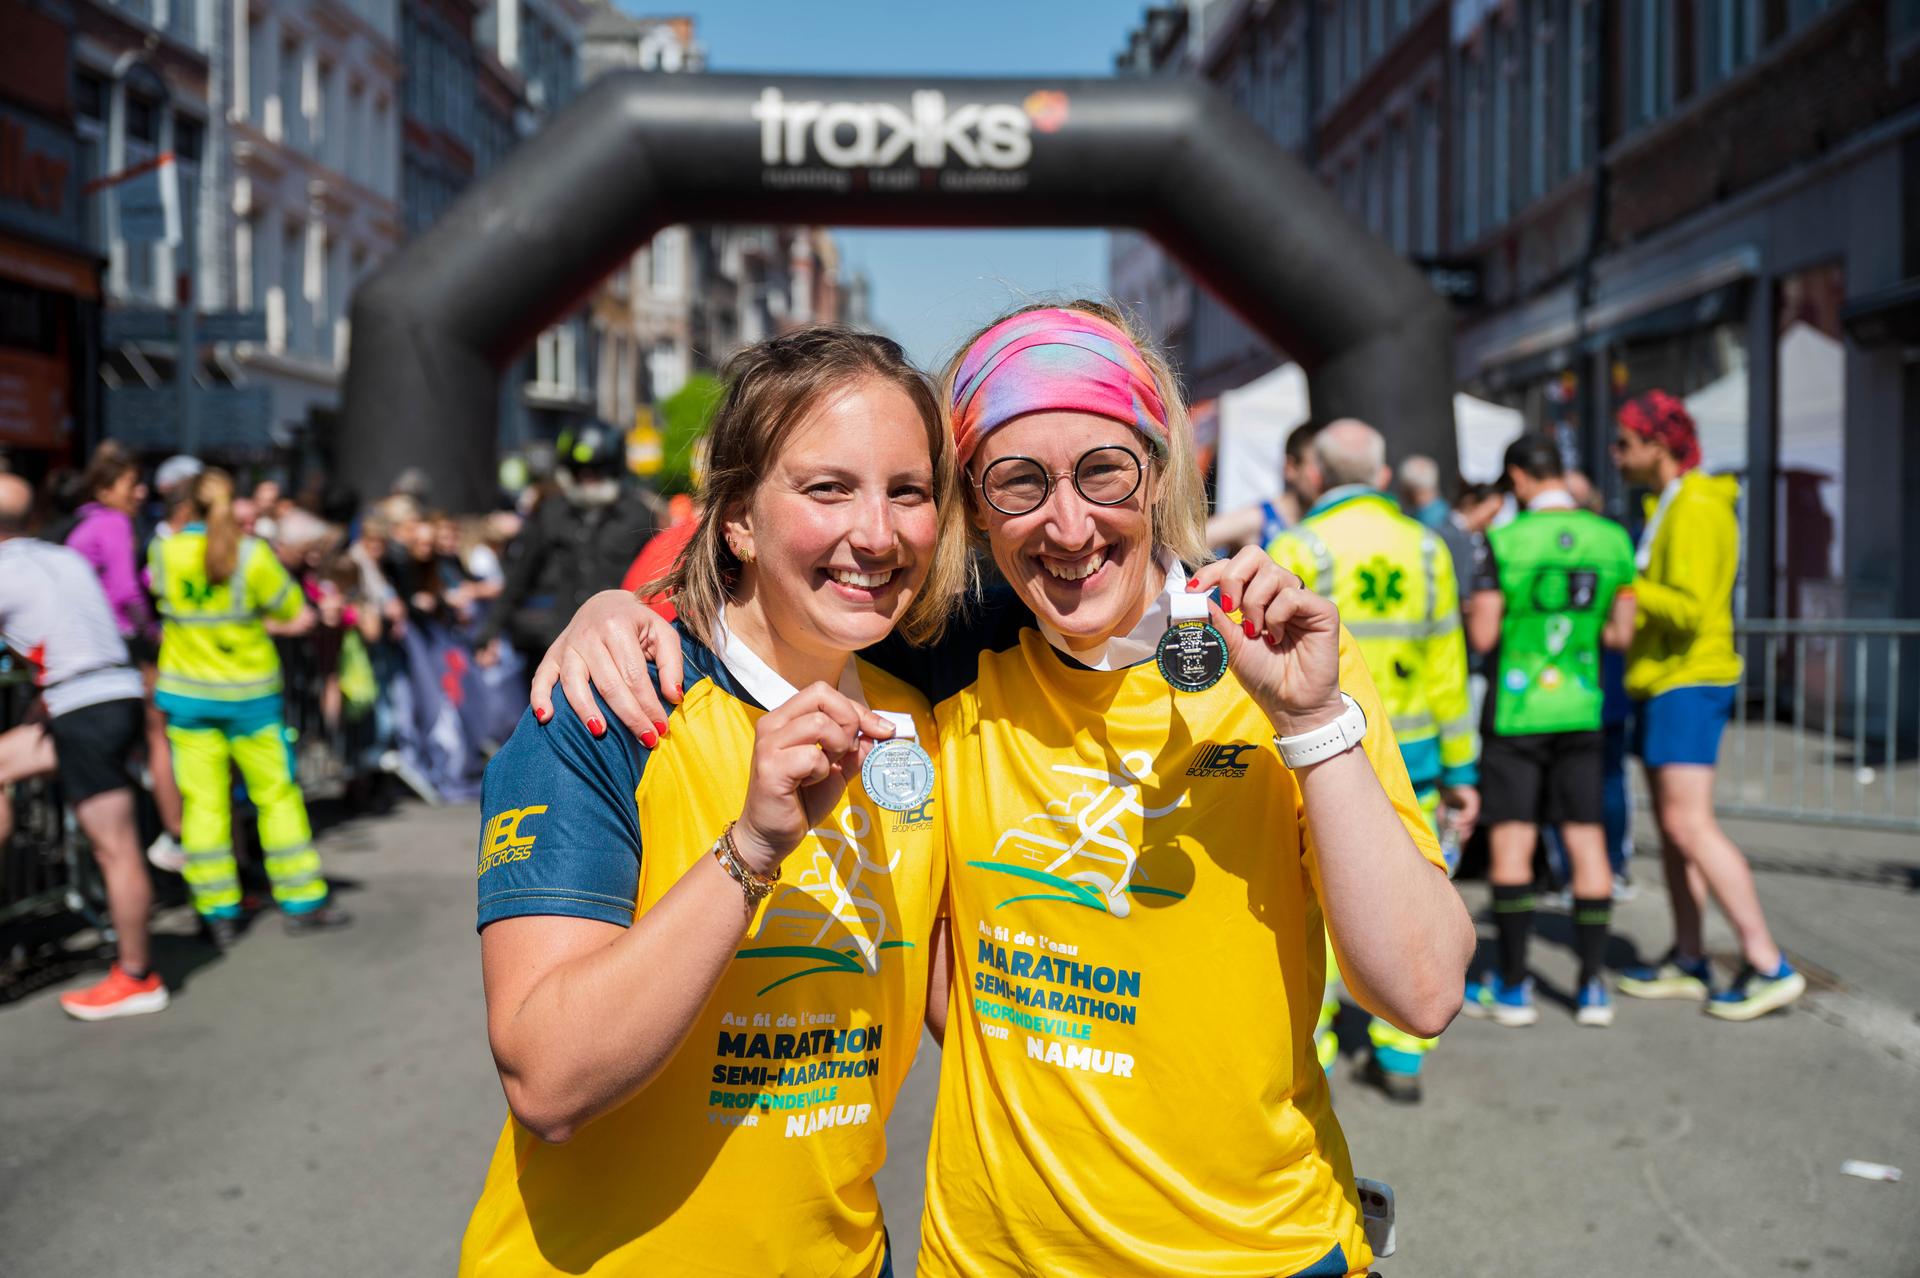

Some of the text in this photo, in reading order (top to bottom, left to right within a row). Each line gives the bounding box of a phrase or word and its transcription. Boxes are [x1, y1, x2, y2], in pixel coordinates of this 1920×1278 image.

[978, 920, 1079, 957] Au fil de l'eau
[977, 938, 1142, 999] MARATHON
[974, 971, 1137, 1026] SEMI-MARATHON
[720, 1011, 837, 1028] Au fil de l'eau
[974, 997, 1093, 1041] PROFONDEVILLE
[716, 1024, 883, 1060] MARATHON
[1026, 1035, 1135, 1079] NAMUR
[711, 1057, 880, 1087] SEMI-MARATHON
[708, 1085, 840, 1111] PROFONDEVILLE
[784, 1103, 872, 1138] NAMUR
